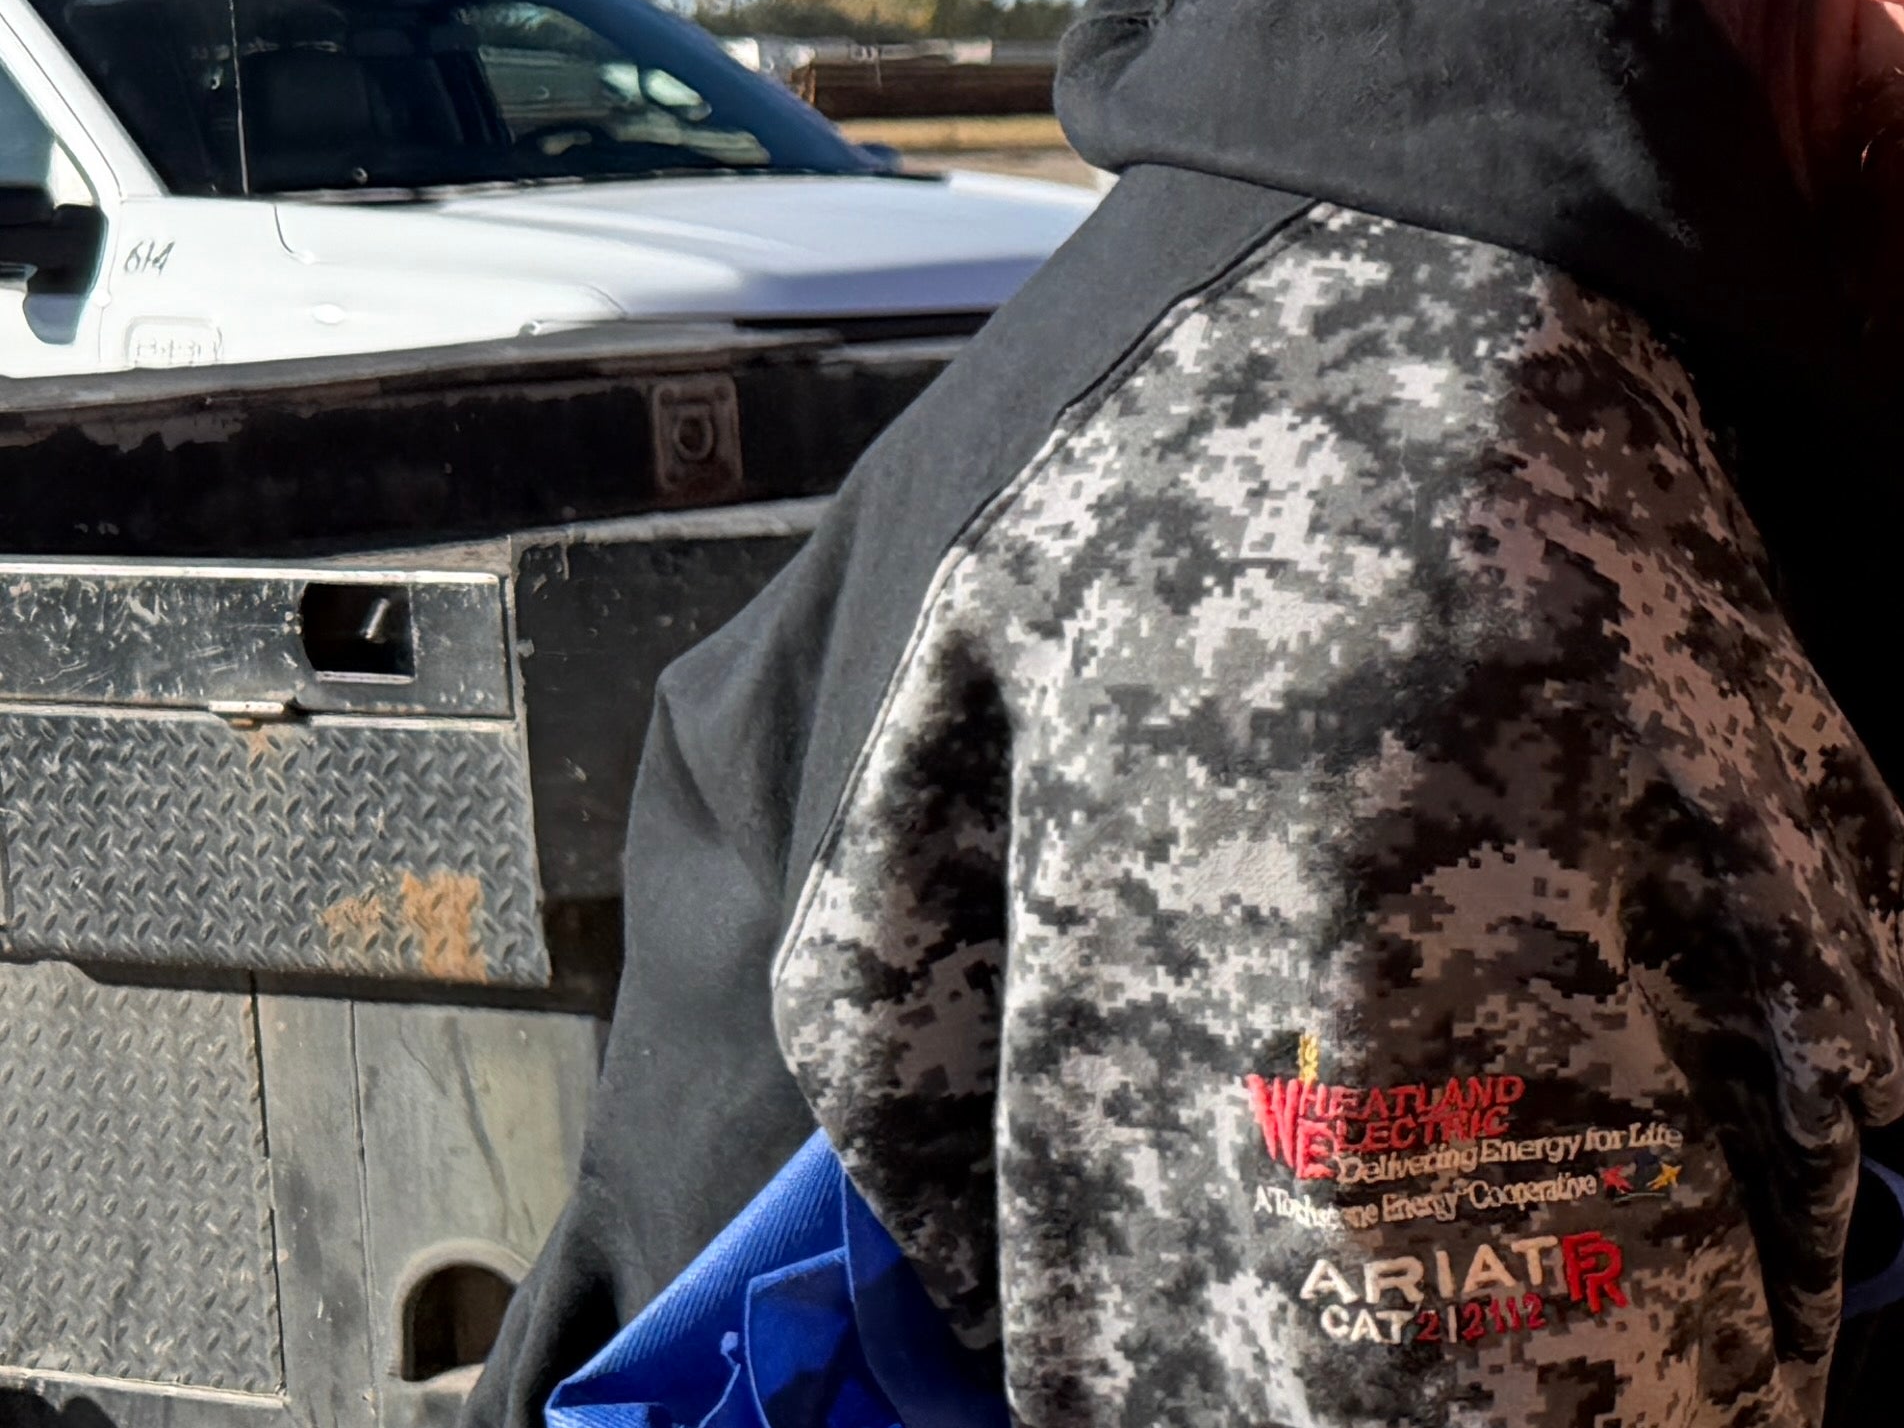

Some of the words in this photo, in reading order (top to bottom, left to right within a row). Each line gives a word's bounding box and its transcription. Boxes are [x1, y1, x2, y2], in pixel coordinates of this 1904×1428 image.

[124, 239, 176, 276] 614
[1336, 1144, 1478, 1184] Delivering
[1480, 1132, 1583, 1165] Energy
[1584, 1125, 1627, 1150] for
[1628, 1122, 1685, 1149] Life
[1381, 1190, 1458, 1222] Energy
[1466, 1173, 1598, 1210] Cooperative
[1300, 1234, 1559, 1304] ARIAT
[1320, 1304, 1414, 1345] CAT
